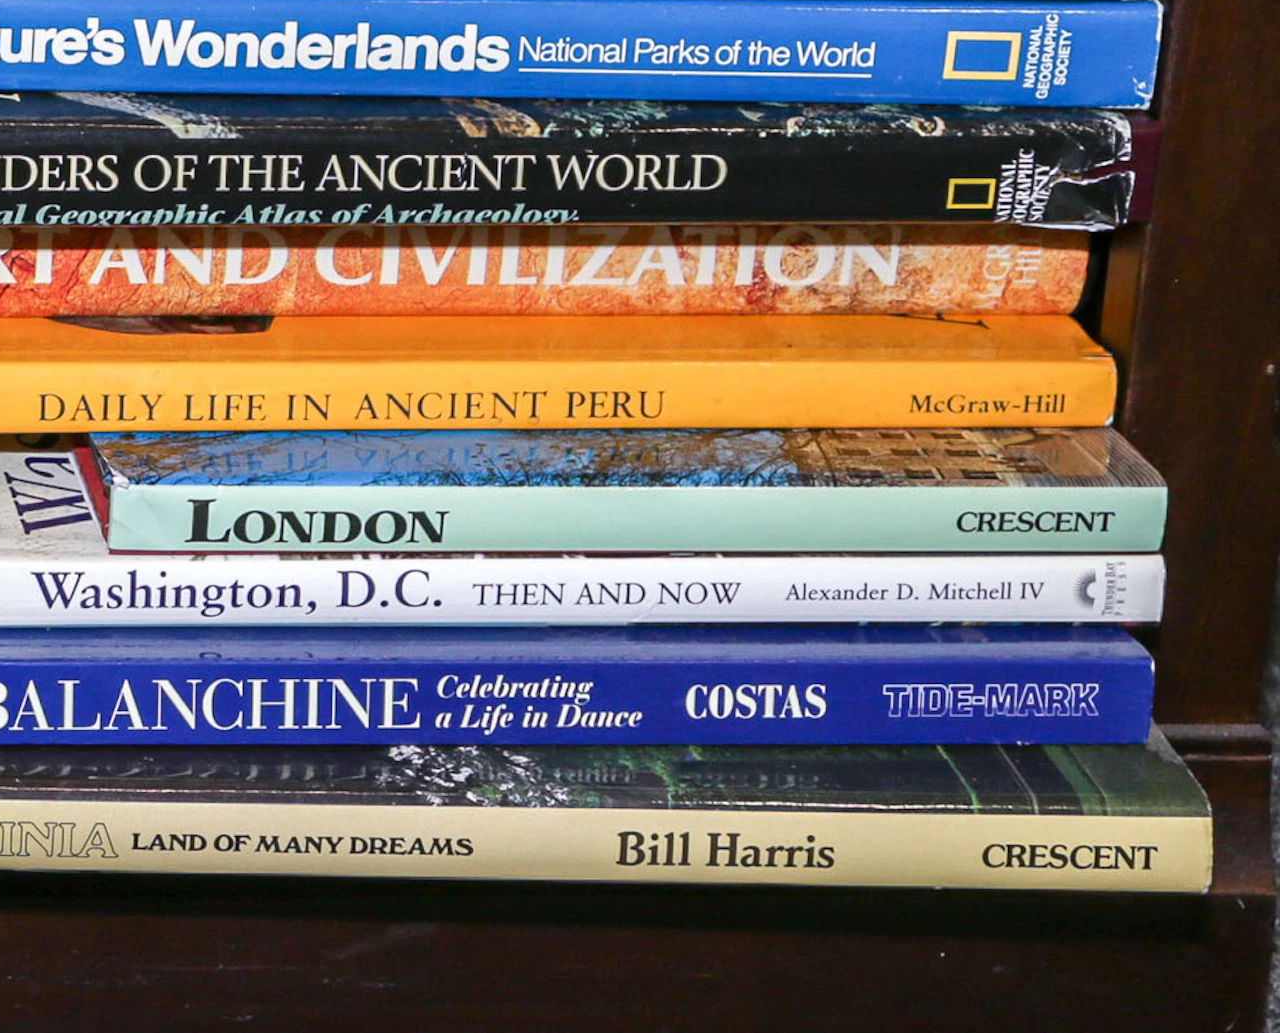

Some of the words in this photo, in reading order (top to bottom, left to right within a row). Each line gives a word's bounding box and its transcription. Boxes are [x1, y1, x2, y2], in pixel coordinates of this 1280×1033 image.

[134, 18, 510, 72] Wonderlands
[517, 35, 626, 64] National
[632, 38, 710, 65] Parks
[714, 40, 742, 65] of
[746, 40, 787, 67] the
[792, 41, 877, 68] World
[134, 155, 198, 191] OF
[208, 154, 305, 192] THE
[315, 155, 537, 192] ANCIENT
[548, 154, 728, 191] WORLD
[39, 393, 163, 422] DAILY
[183, 395, 266, 422] LIFE
[286, 395, 331, 420] IN
[355, 391, 548, 422] ANCIENT
[567, 391, 666, 419] PERU
[909, 393, 1066, 415] McGraw-Hill
[956, 511, 1116, 534] CRESCENT
[31, 570, 316, 615] Washington,
[336, 569, 442, 608] D.C.
[785, 584, 889, 601] Alexander
[895, 584, 918, 601] D.
[927, 582, 1011, 600] Mitchell
[1017, 582, 1044, 600] IV
[436, 674, 594, 705] Celebrating
[685, 684, 827, 720] COSTAS
[883, 683, 1099, 718] TIDE-MARK
[434, 712, 452, 728] a
[460, 703, 514, 735] Life
[522, 705, 548, 728] in
[556, 703, 643, 728] Dance
[617, 831, 692, 868] Bill
[706, 832, 834, 869] Harris
[982, 843, 1157, 870] CRESCENT
